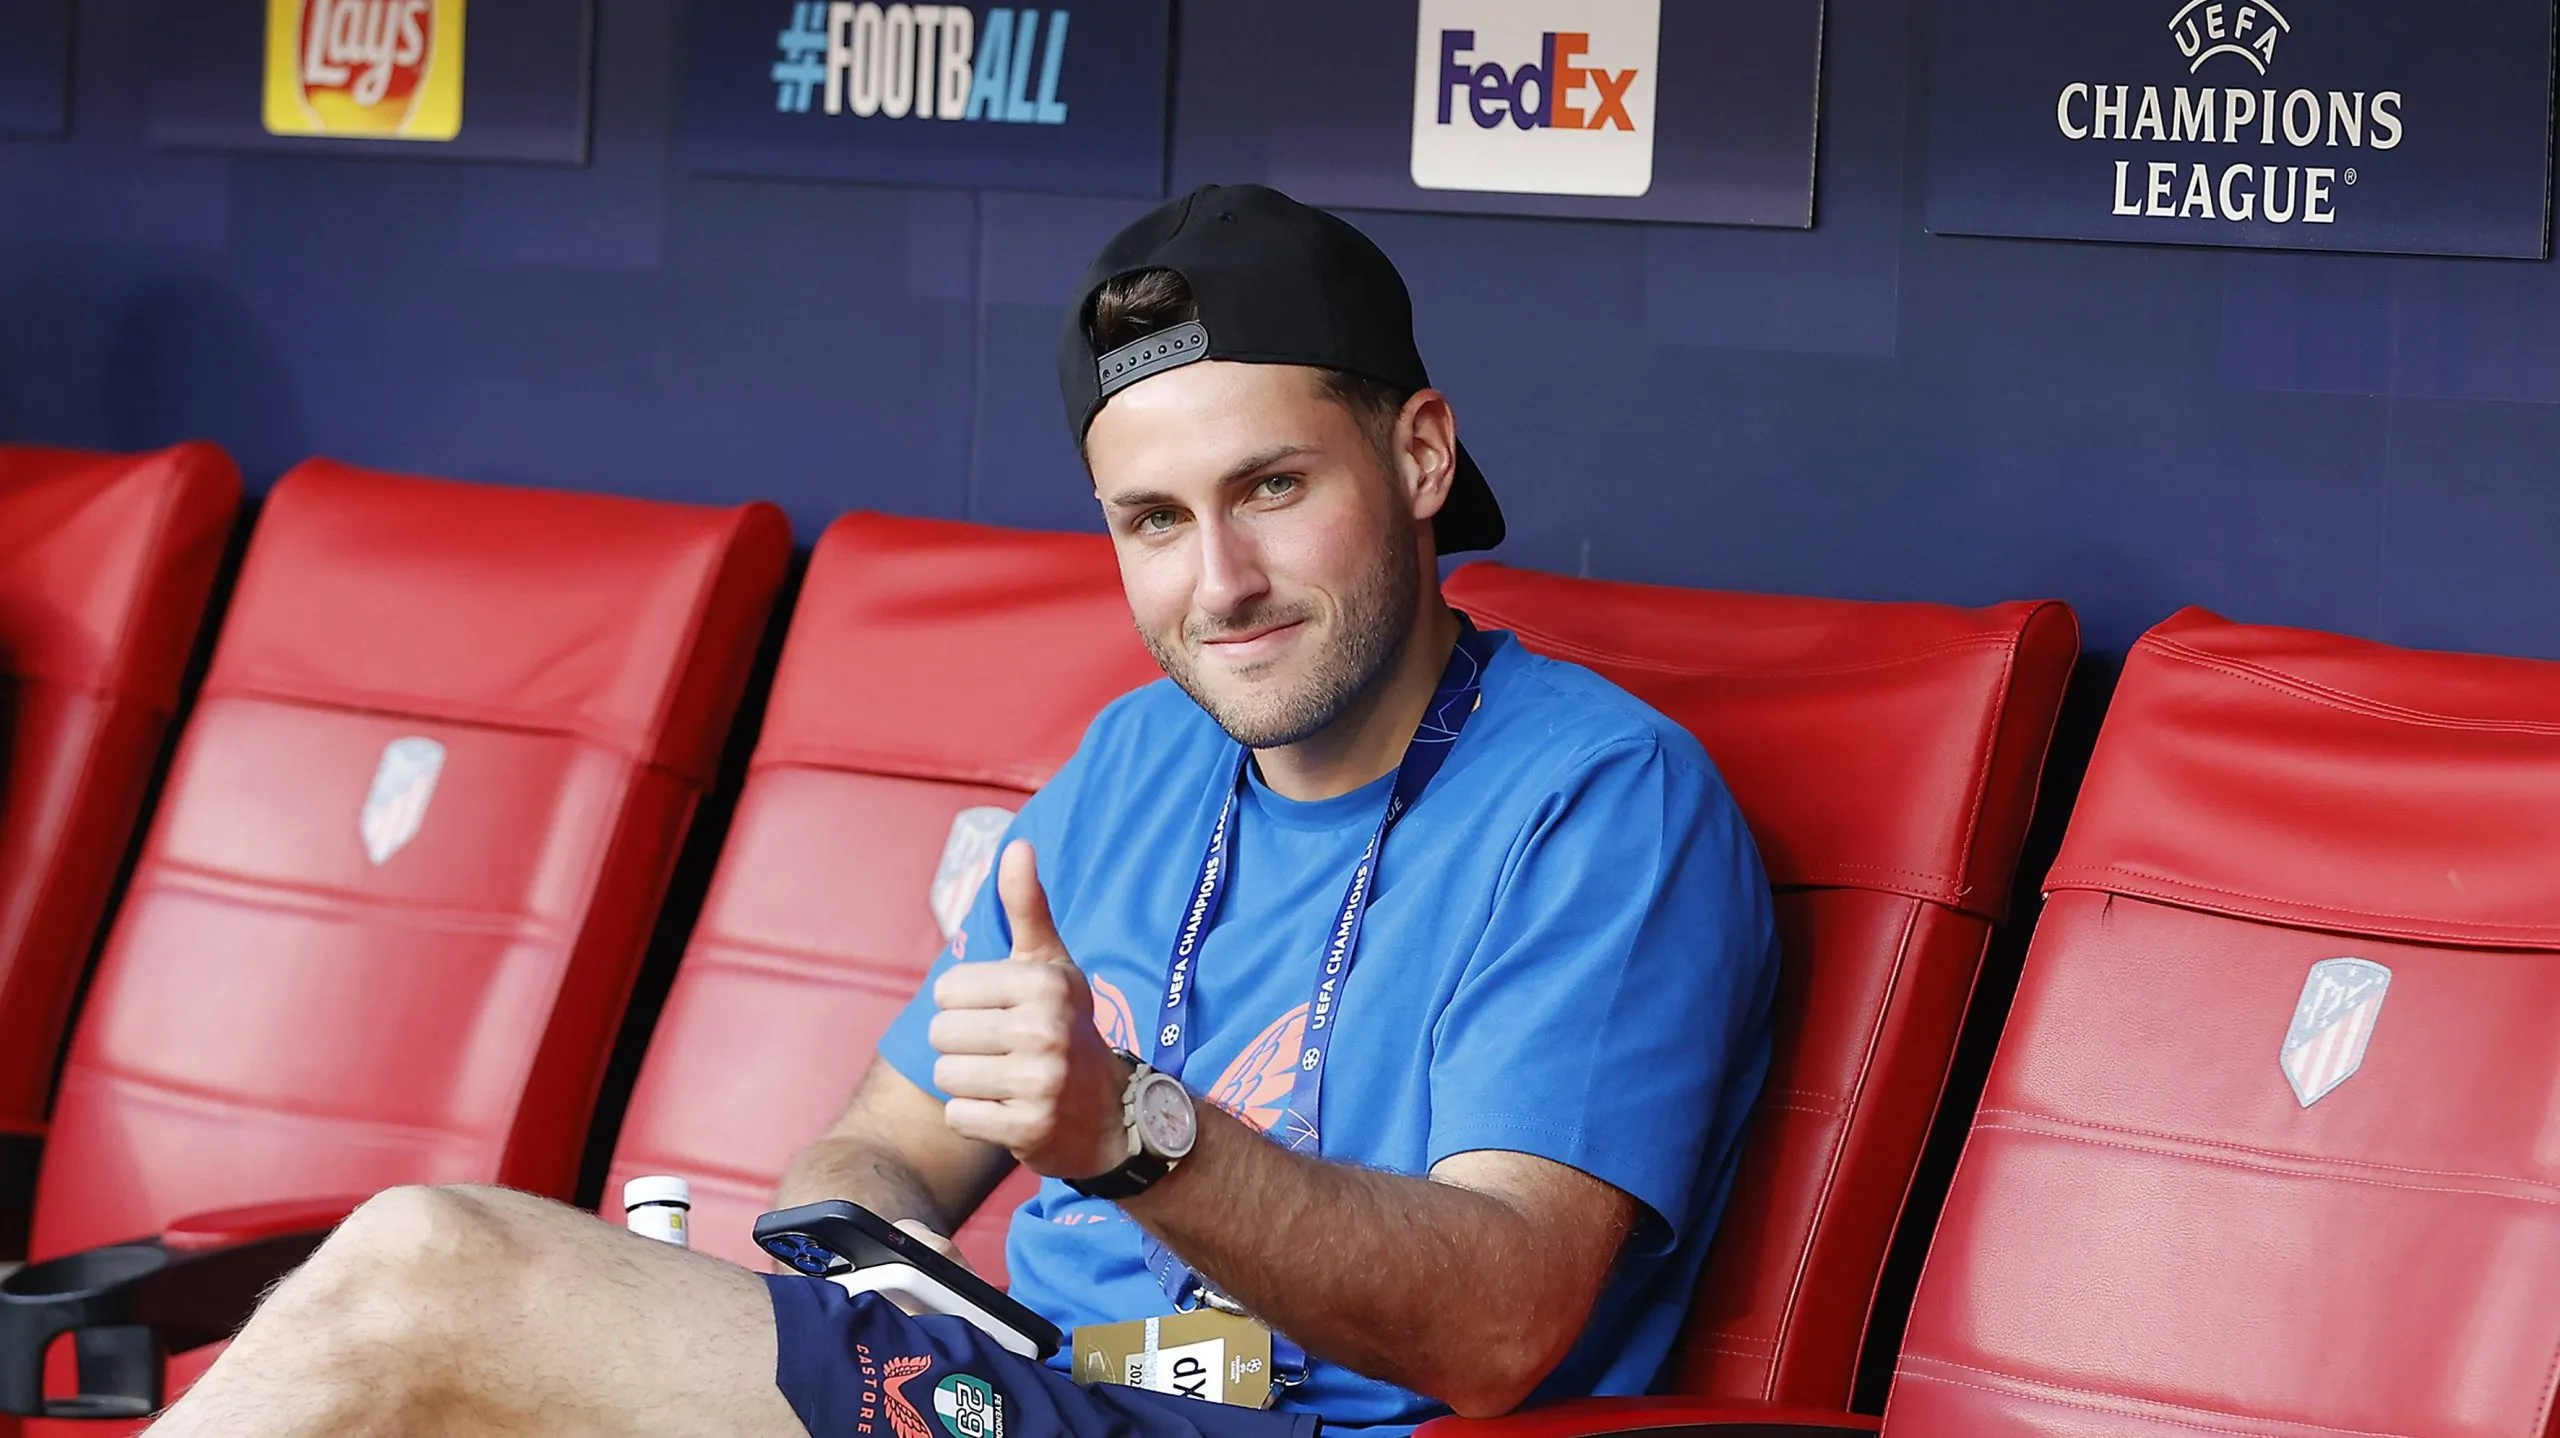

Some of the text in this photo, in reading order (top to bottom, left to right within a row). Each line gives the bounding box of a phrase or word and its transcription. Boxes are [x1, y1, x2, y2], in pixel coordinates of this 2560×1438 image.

[772, 1, 1070, 124] #FOOTBALL
[1437, 29, 1638, 131] FedEx
[2174, 3, 2278, 65] UEFA
[2057, 82, 2403, 149] CHAMPIONS
[1166, 957, 1189, 1008] UEFA
[1178, 856, 1220, 956] CHAMPIONS
[1311, 865, 1368, 1030] UEFA CHAMPIONS
[856, 1344, 878, 1434] CASTORE
[956, 1380, 985, 1438] 29
